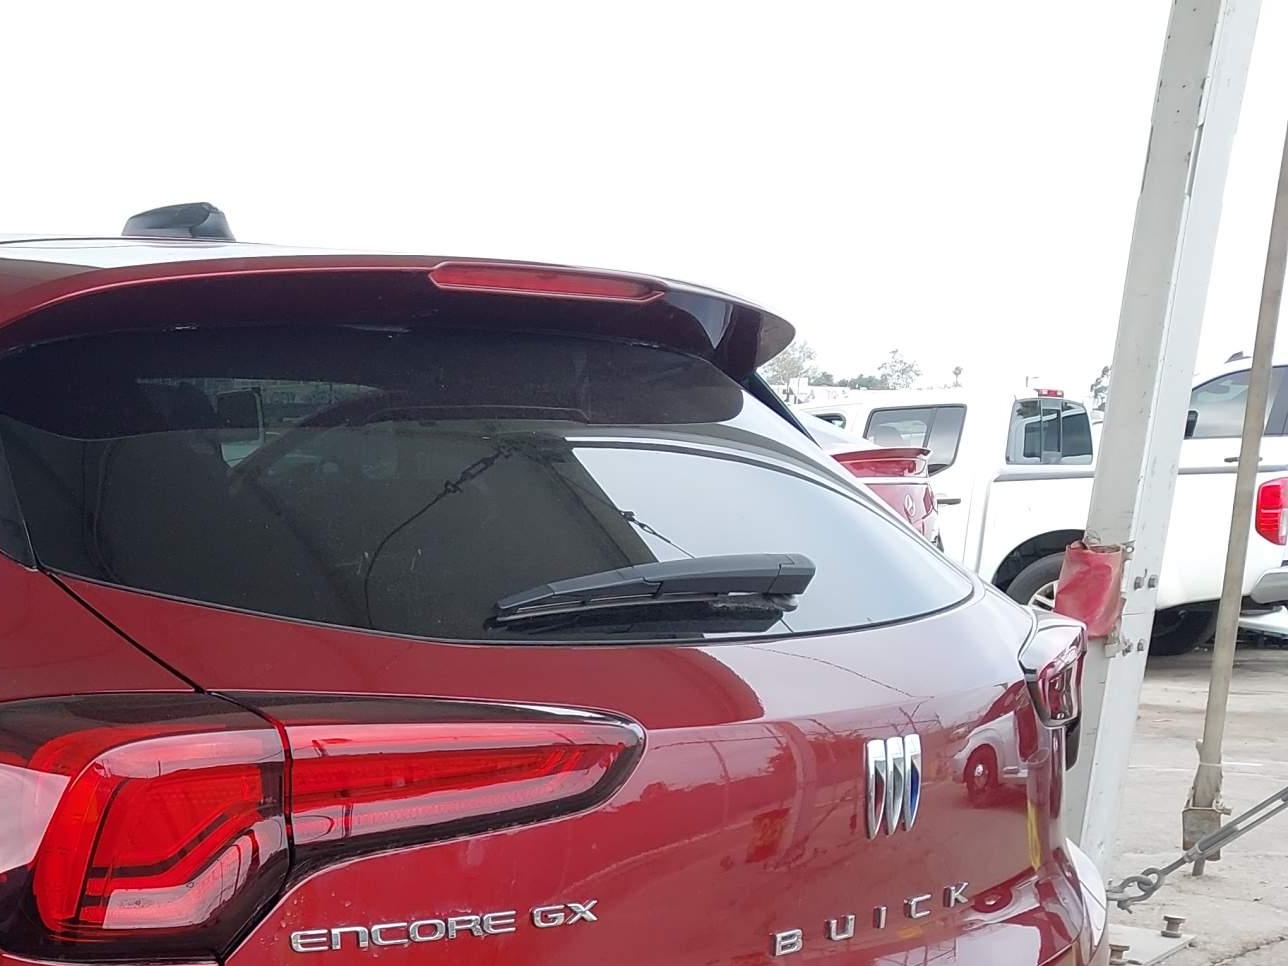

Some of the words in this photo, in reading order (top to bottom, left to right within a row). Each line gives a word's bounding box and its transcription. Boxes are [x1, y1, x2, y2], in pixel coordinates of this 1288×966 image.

[290, 910, 517, 953] ENCORE
[532, 899, 598, 929] GX
[770, 882, 969, 957] BUICK
